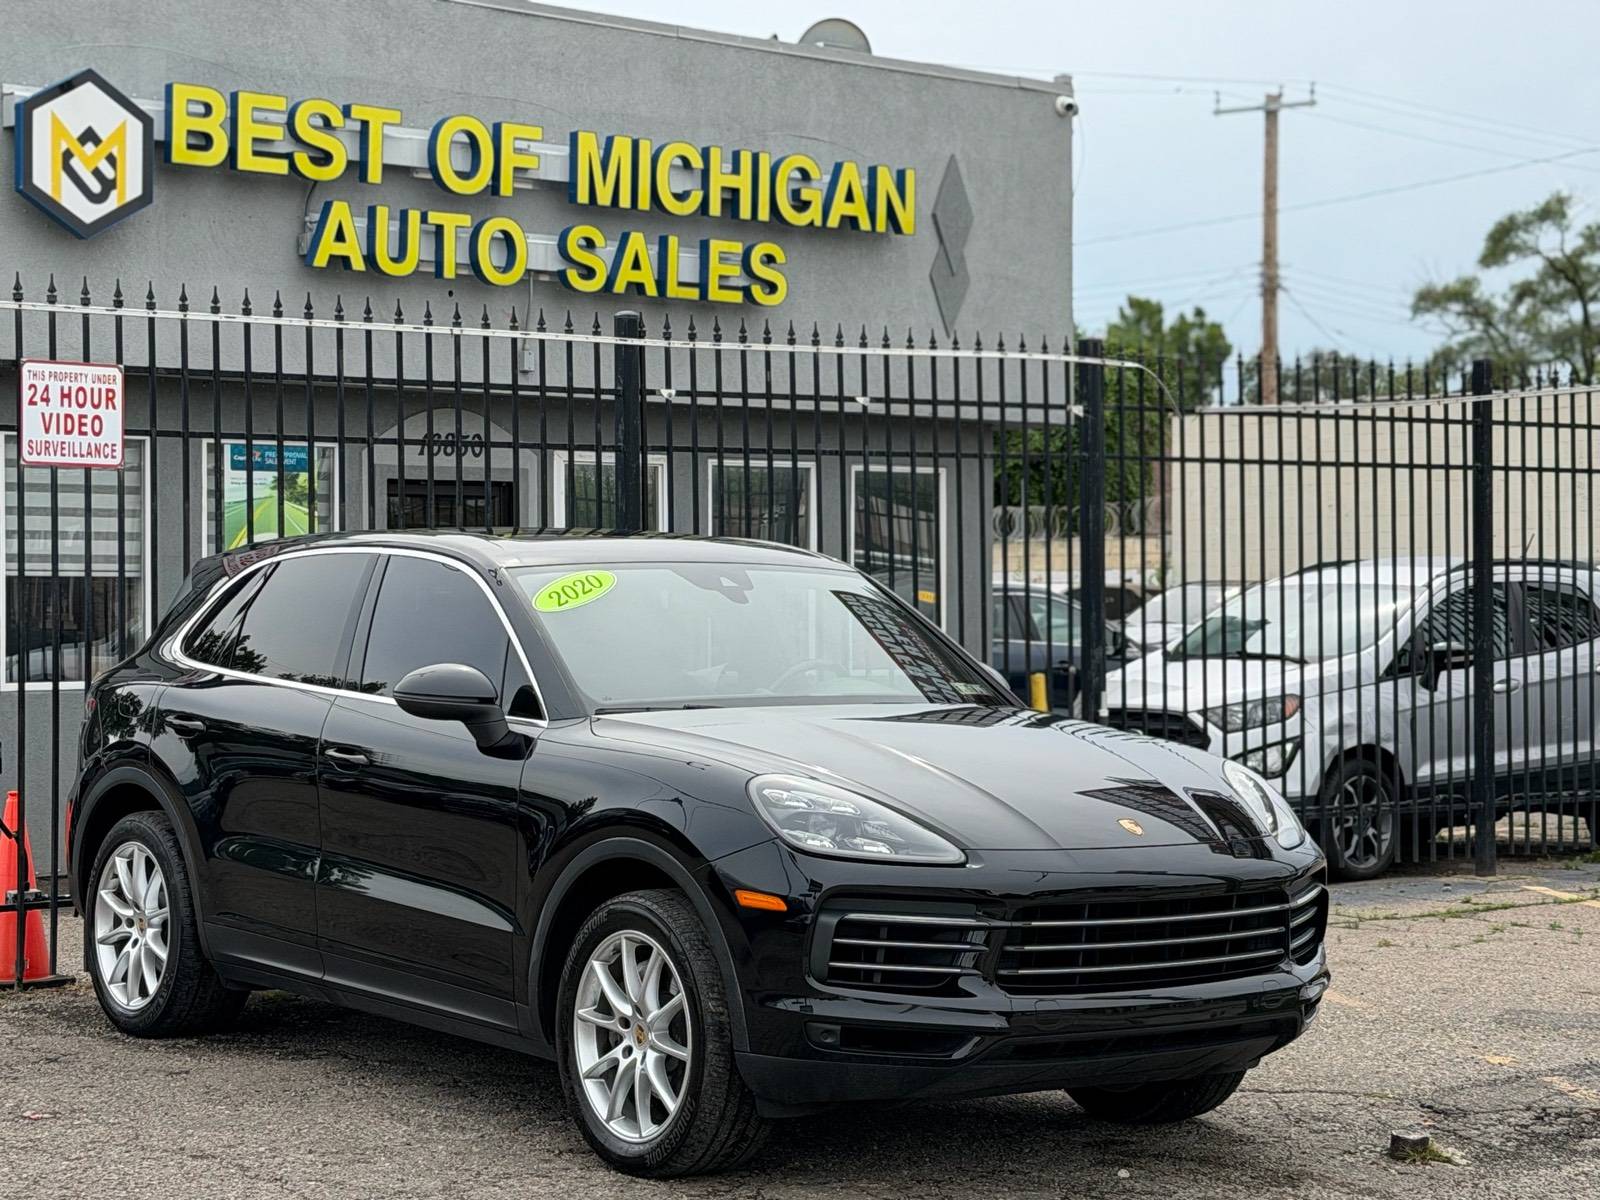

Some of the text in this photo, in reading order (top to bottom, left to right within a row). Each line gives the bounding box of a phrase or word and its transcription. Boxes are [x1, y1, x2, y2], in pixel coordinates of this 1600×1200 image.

[165, 82, 916, 236] BEST OF MICHIGAN
[305, 200, 789, 306] AUTO SALES
[27, 369, 117, 385] THIS PROPERTY UNDER
[27, 383, 116, 410] 24 HOUR
[41, 411, 103, 437] VIDEO
[27, 439, 117, 459] SURVEILLANCE
[548, 574, 604, 608] 2020
[562, 910, 609, 979] BRIDGESTONE
[645, 1095, 697, 1168] BRIDGESTONE
